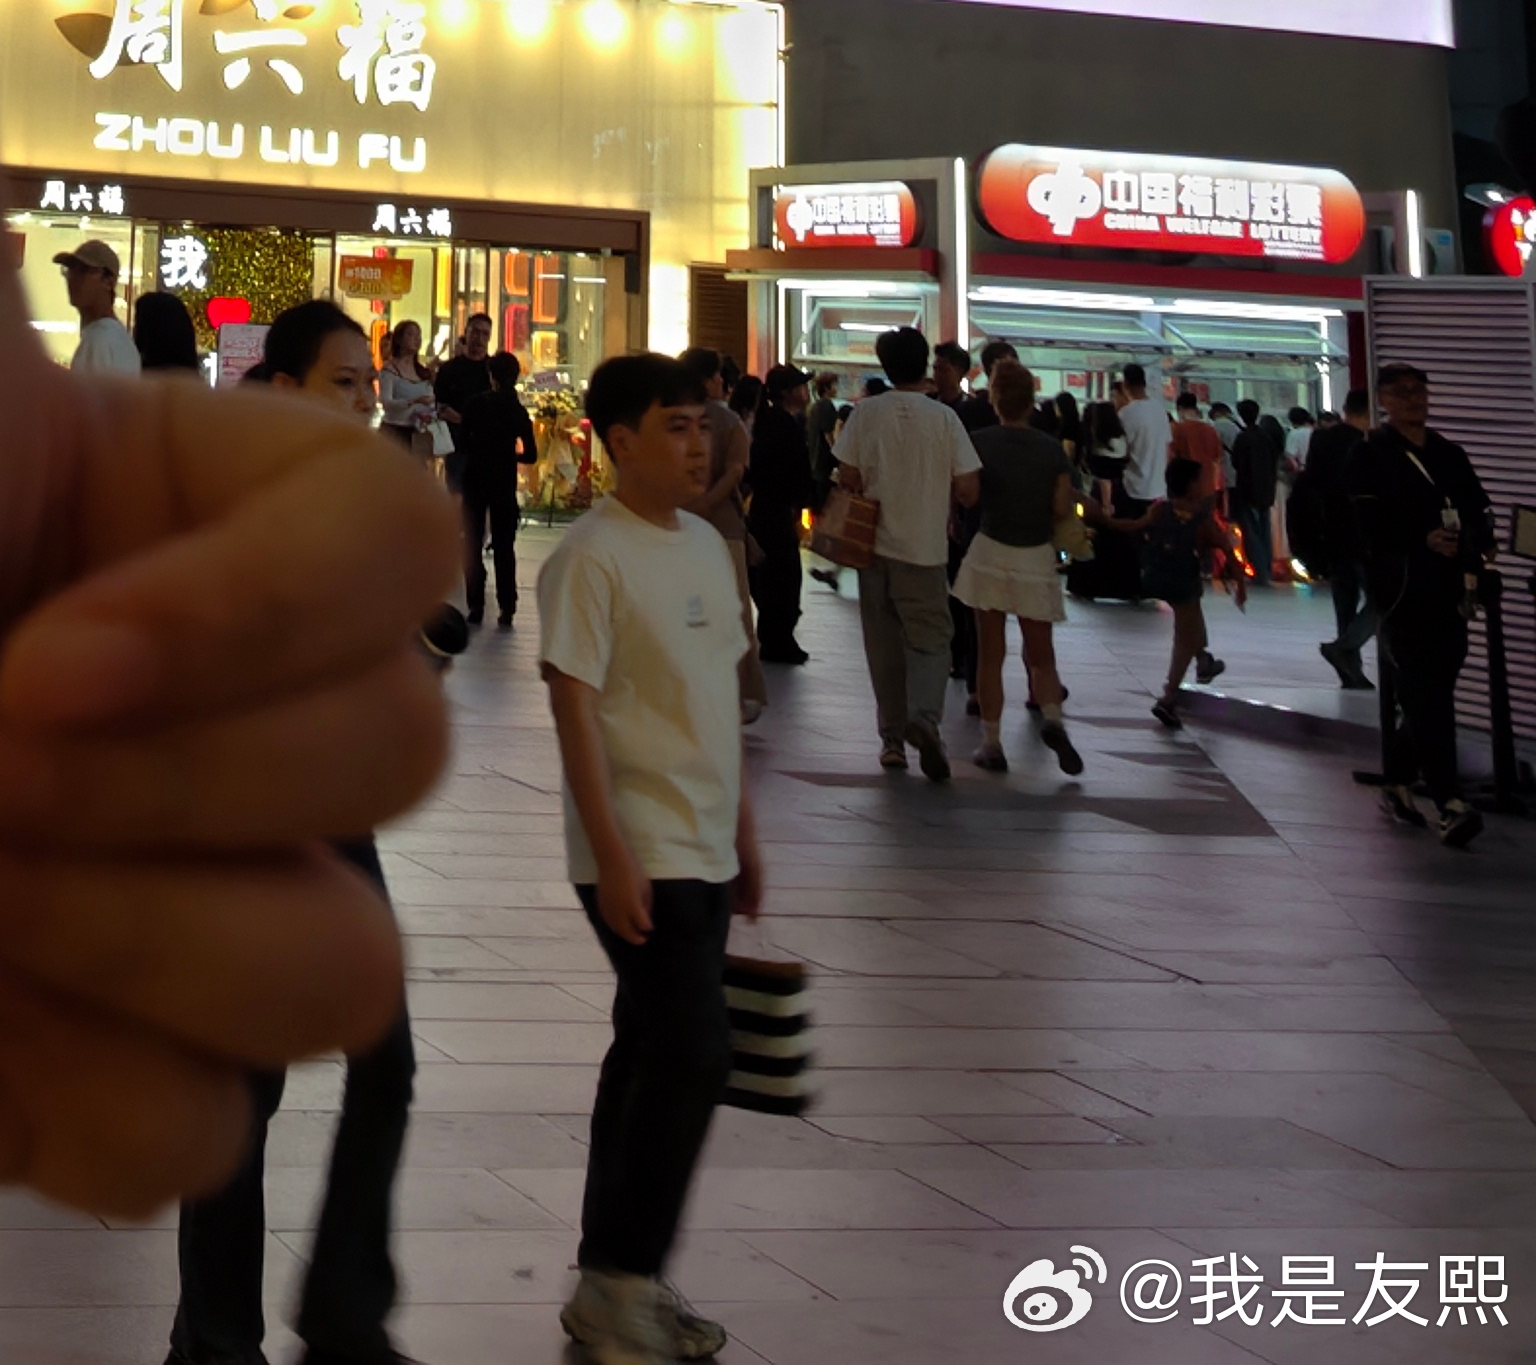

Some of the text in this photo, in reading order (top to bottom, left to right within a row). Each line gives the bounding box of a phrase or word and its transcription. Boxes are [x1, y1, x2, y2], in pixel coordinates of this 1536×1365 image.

[93, 112, 426, 173] ZHOU LIU FU
[161, 235, 208, 290] 我
